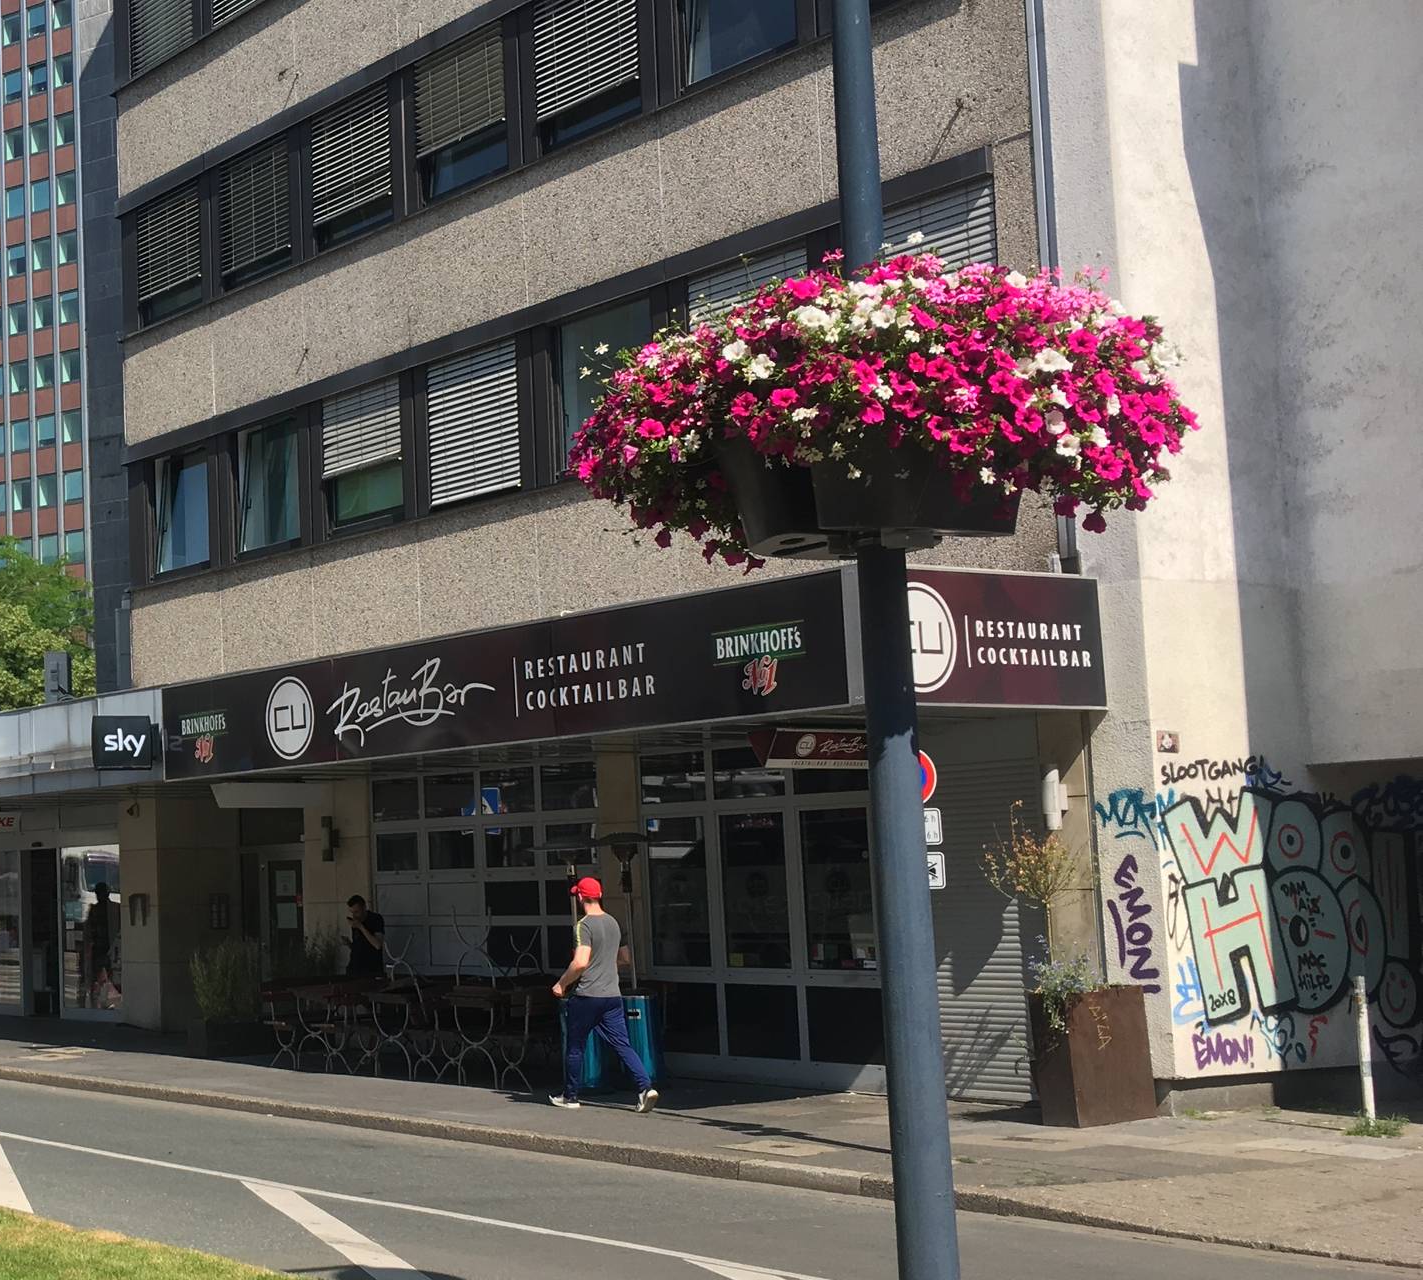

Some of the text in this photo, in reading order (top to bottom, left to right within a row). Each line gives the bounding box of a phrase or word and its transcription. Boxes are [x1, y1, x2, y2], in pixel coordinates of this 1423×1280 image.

[716, 626, 802, 659] BRINKHOFF's
[976, 619, 1082, 641] RESTAURANT
[524, 642, 645, 680] RESTAURANT
[977, 646, 1092, 668] COCKTAILBAR
[326, 657, 496, 747] RestauBar
[526, 674, 656, 711] COCKTAILBAR
[181, 713, 226, 736] BRINKHOFF's
[274, 702, 307, 733] CU
[103, 727, 146, 758] sky
